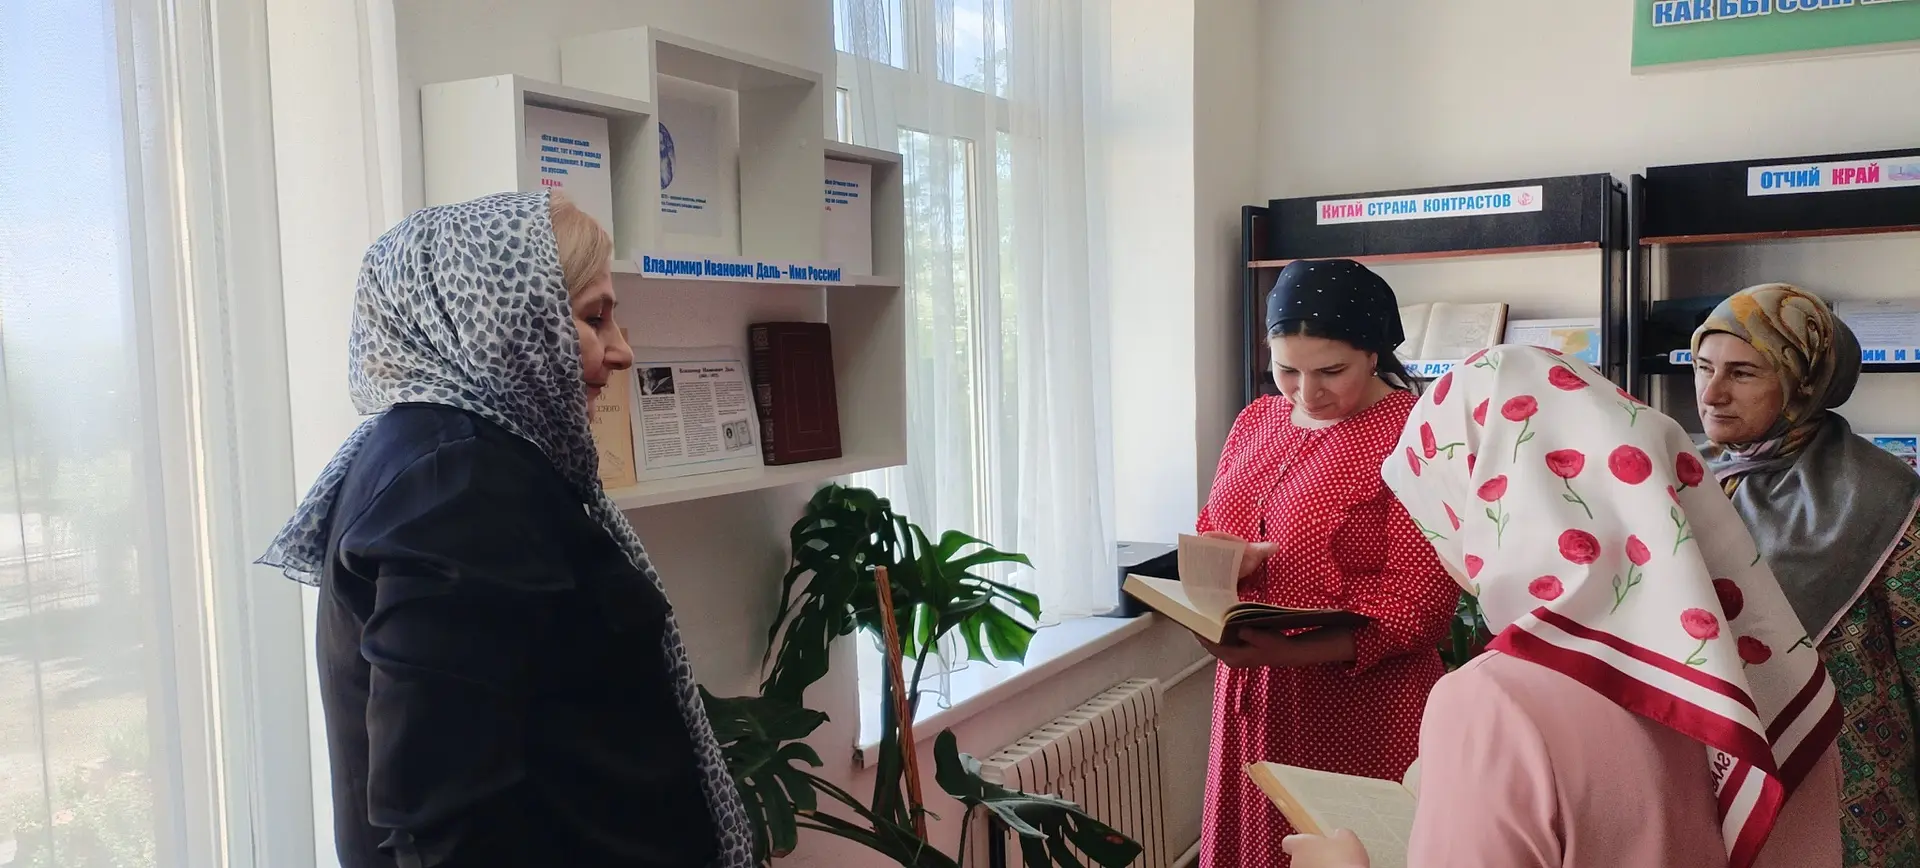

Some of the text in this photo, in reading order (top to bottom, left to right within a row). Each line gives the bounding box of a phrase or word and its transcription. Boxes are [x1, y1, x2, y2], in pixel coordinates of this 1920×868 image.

[1655, 0, 1712, 24] КАК
[1760, 162, 1880, 189] ОТЧИЙ КРАЙ
[1367, 199, 1417, 216] СТРАНА
[1423, 193, 1511, 213] КОНТРАСТОВ
[643, 255, 703, 277] Владимир
[704, 259, 753, 278] Иванович
[756, 262, 781, 280] Даль
[788, 264, 808, 281] Имя
[808, 265, 841, 282] России!
